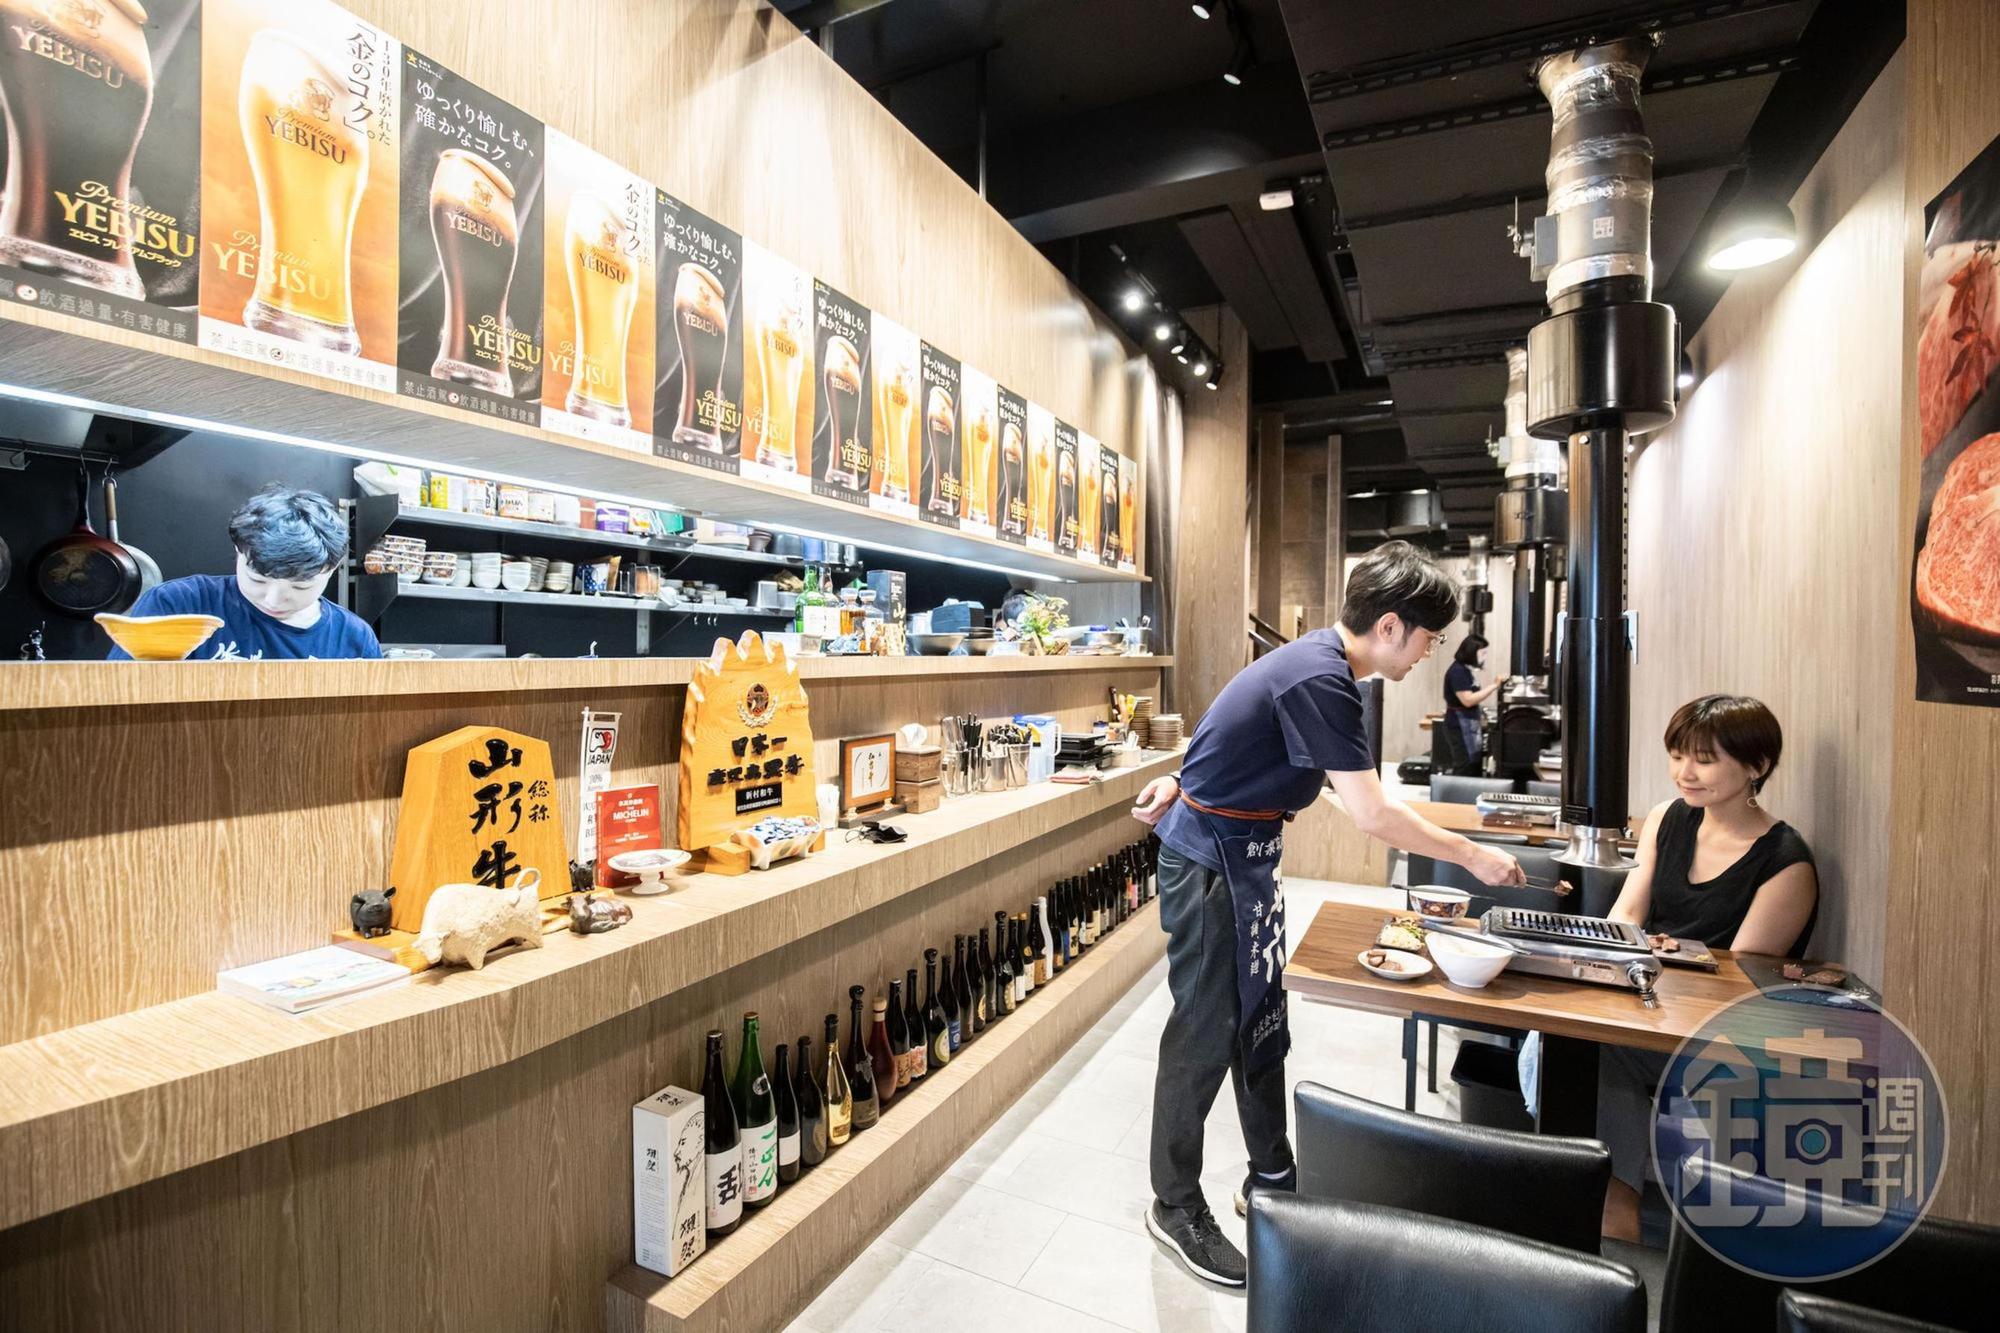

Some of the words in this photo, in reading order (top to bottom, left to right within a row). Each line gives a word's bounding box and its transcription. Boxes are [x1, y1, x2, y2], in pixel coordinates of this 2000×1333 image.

[11, 25, 124, 89] YEBISU
[278, 107, 337, 142] Premium
[415, 103, 512, 169] 確かなコク。
[416, 78, 534, 157] ゆっくり愉しむ、
[265, 115, 346, 165] YEBISU
[54, 190, 196, 258] YEBISU
[75, 180, 177, 226] Premium
[446, 211, 504, 248] YEBISU
[578, 252, 625, 285] YEBISU
[468, 324, 542, 365] YEBISU
[478, 314, 532, 342] Premium
[683, 312, 718, 337] YEBISU
[588, 754, 612, 765] JAPAN
[469, 738, 523, 890] 山形牛
[528, 780, 551, 824] 総称
[612, 808, 650, 821] MICHELIN
